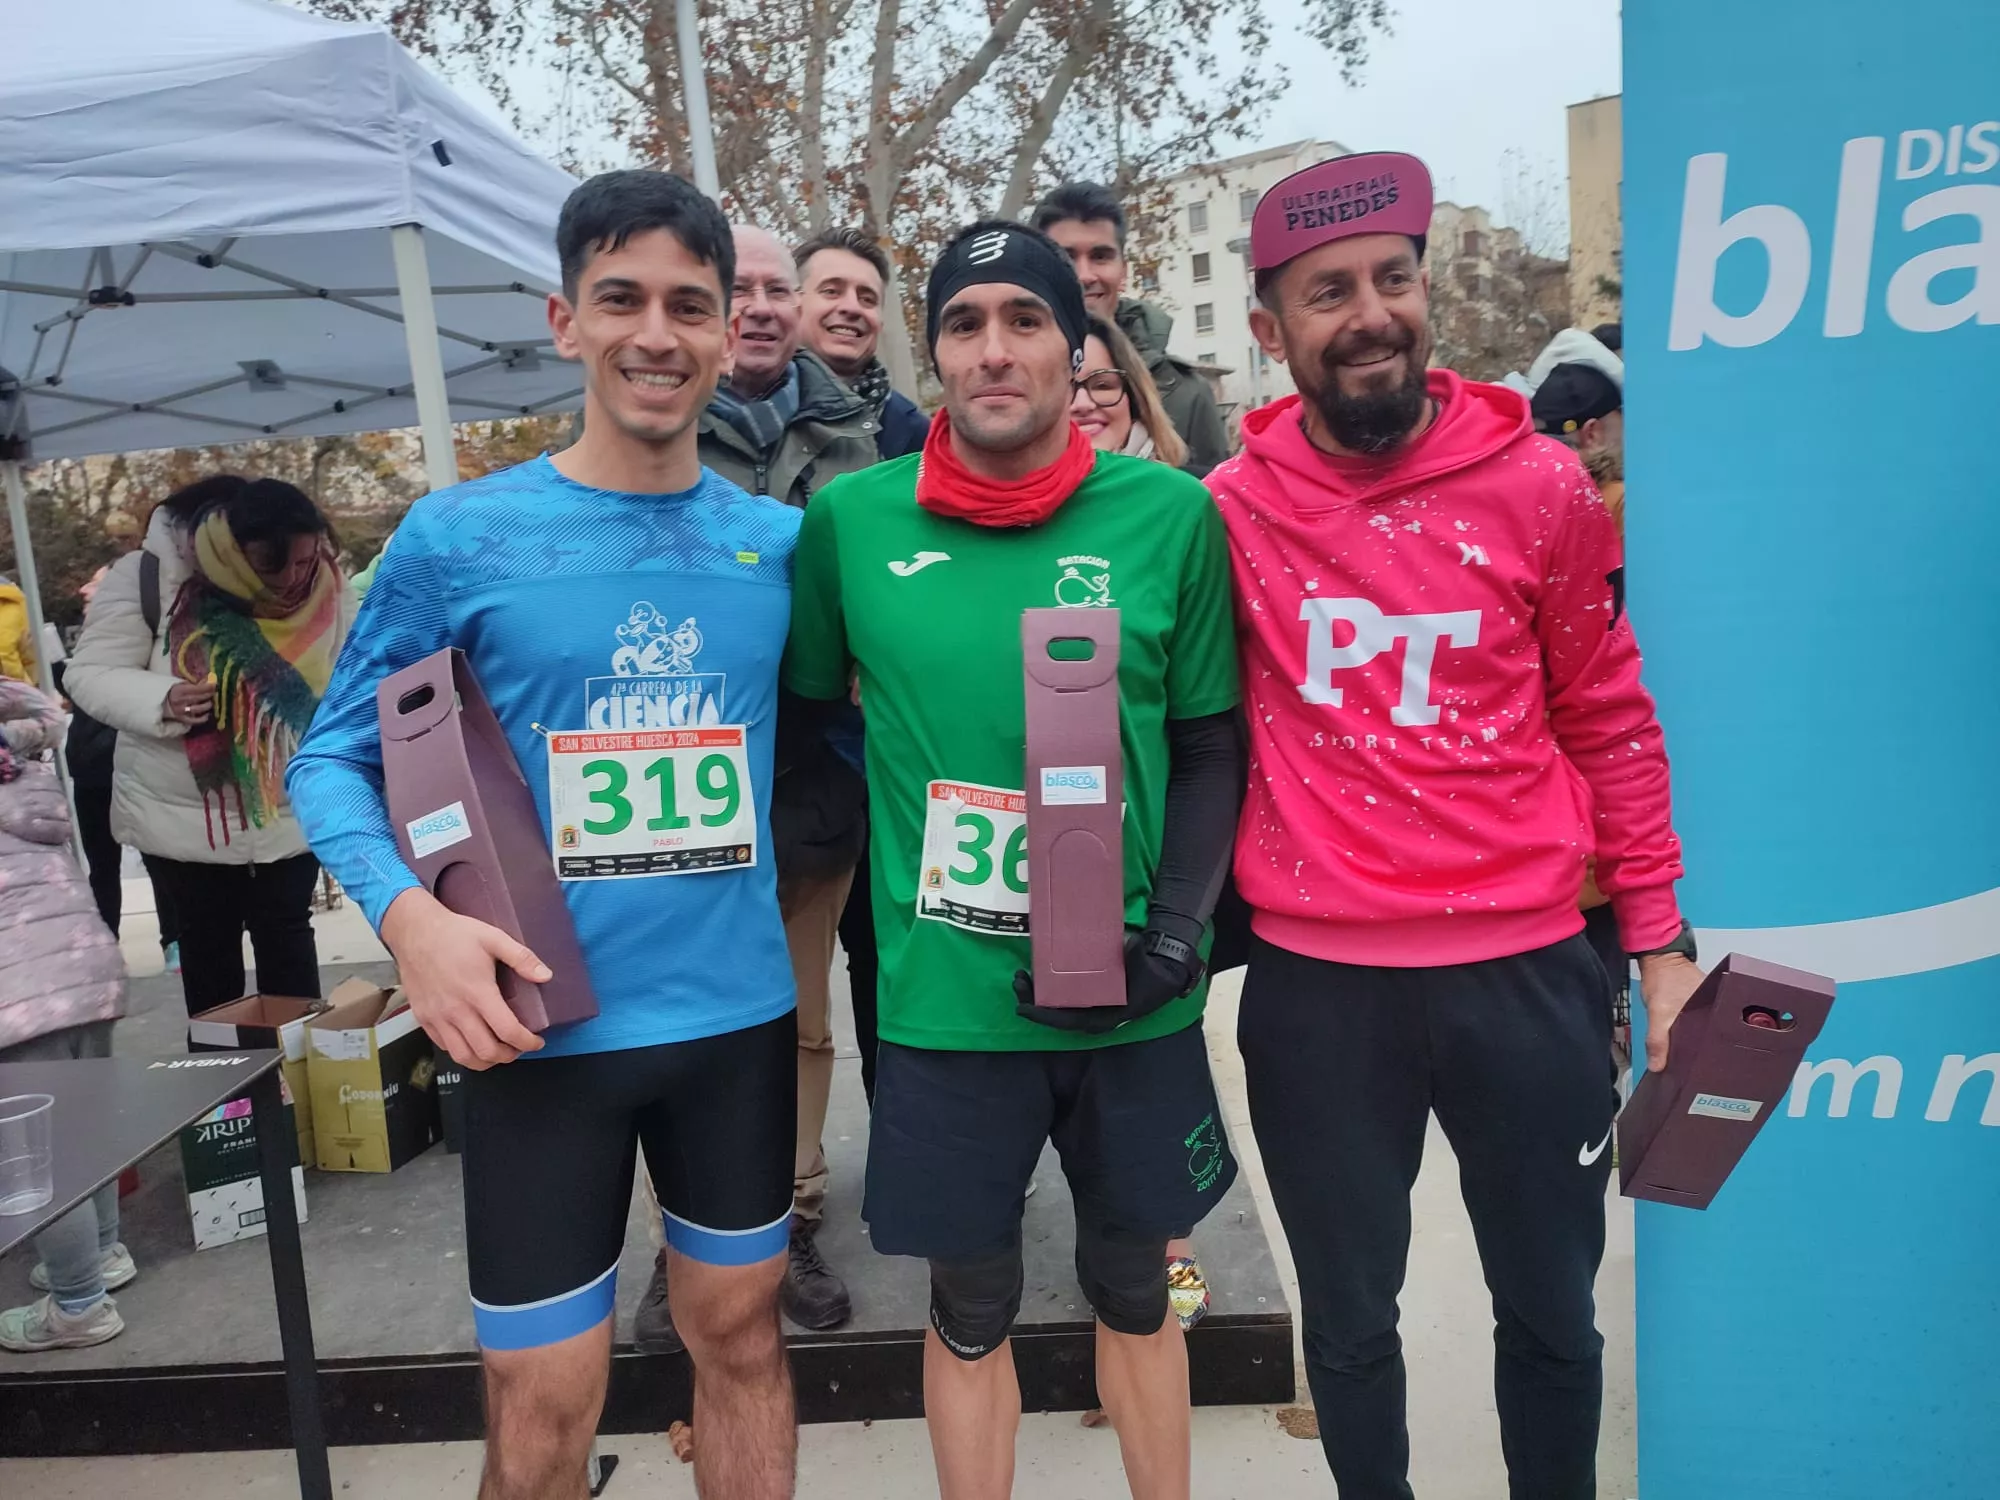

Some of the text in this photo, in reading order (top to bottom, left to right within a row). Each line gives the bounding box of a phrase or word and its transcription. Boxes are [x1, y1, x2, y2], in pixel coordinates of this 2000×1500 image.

[1281, 172, 1399, 211] ULTRATRAIL
[1285, 187, 1398, 232] PENEDES
[1296, 597, 1482, 726] PT
[629, 680, 672, 696] CARRERA
[675, 678, 690, 695] DE
[691, 678, 703, 694] LA
[590, 693, 719, 730] CIENCIA
[559, 731, 700, 751] SAN SILVESTRE HUESCA 2024
[1420, 726, 1498, 750] TEAM
[1046, 773, 1093, 787] blasco
[582, 753, 741, 835] 319
[958, 789, 1005, 808] SILVESTRE
[412, 815, 454, 840] blasco
[653, 837, 683, 847] PABLO
[1697, 1097, 1747, 1112] blasco
[195, 1116, 254, 1144] KRIP
